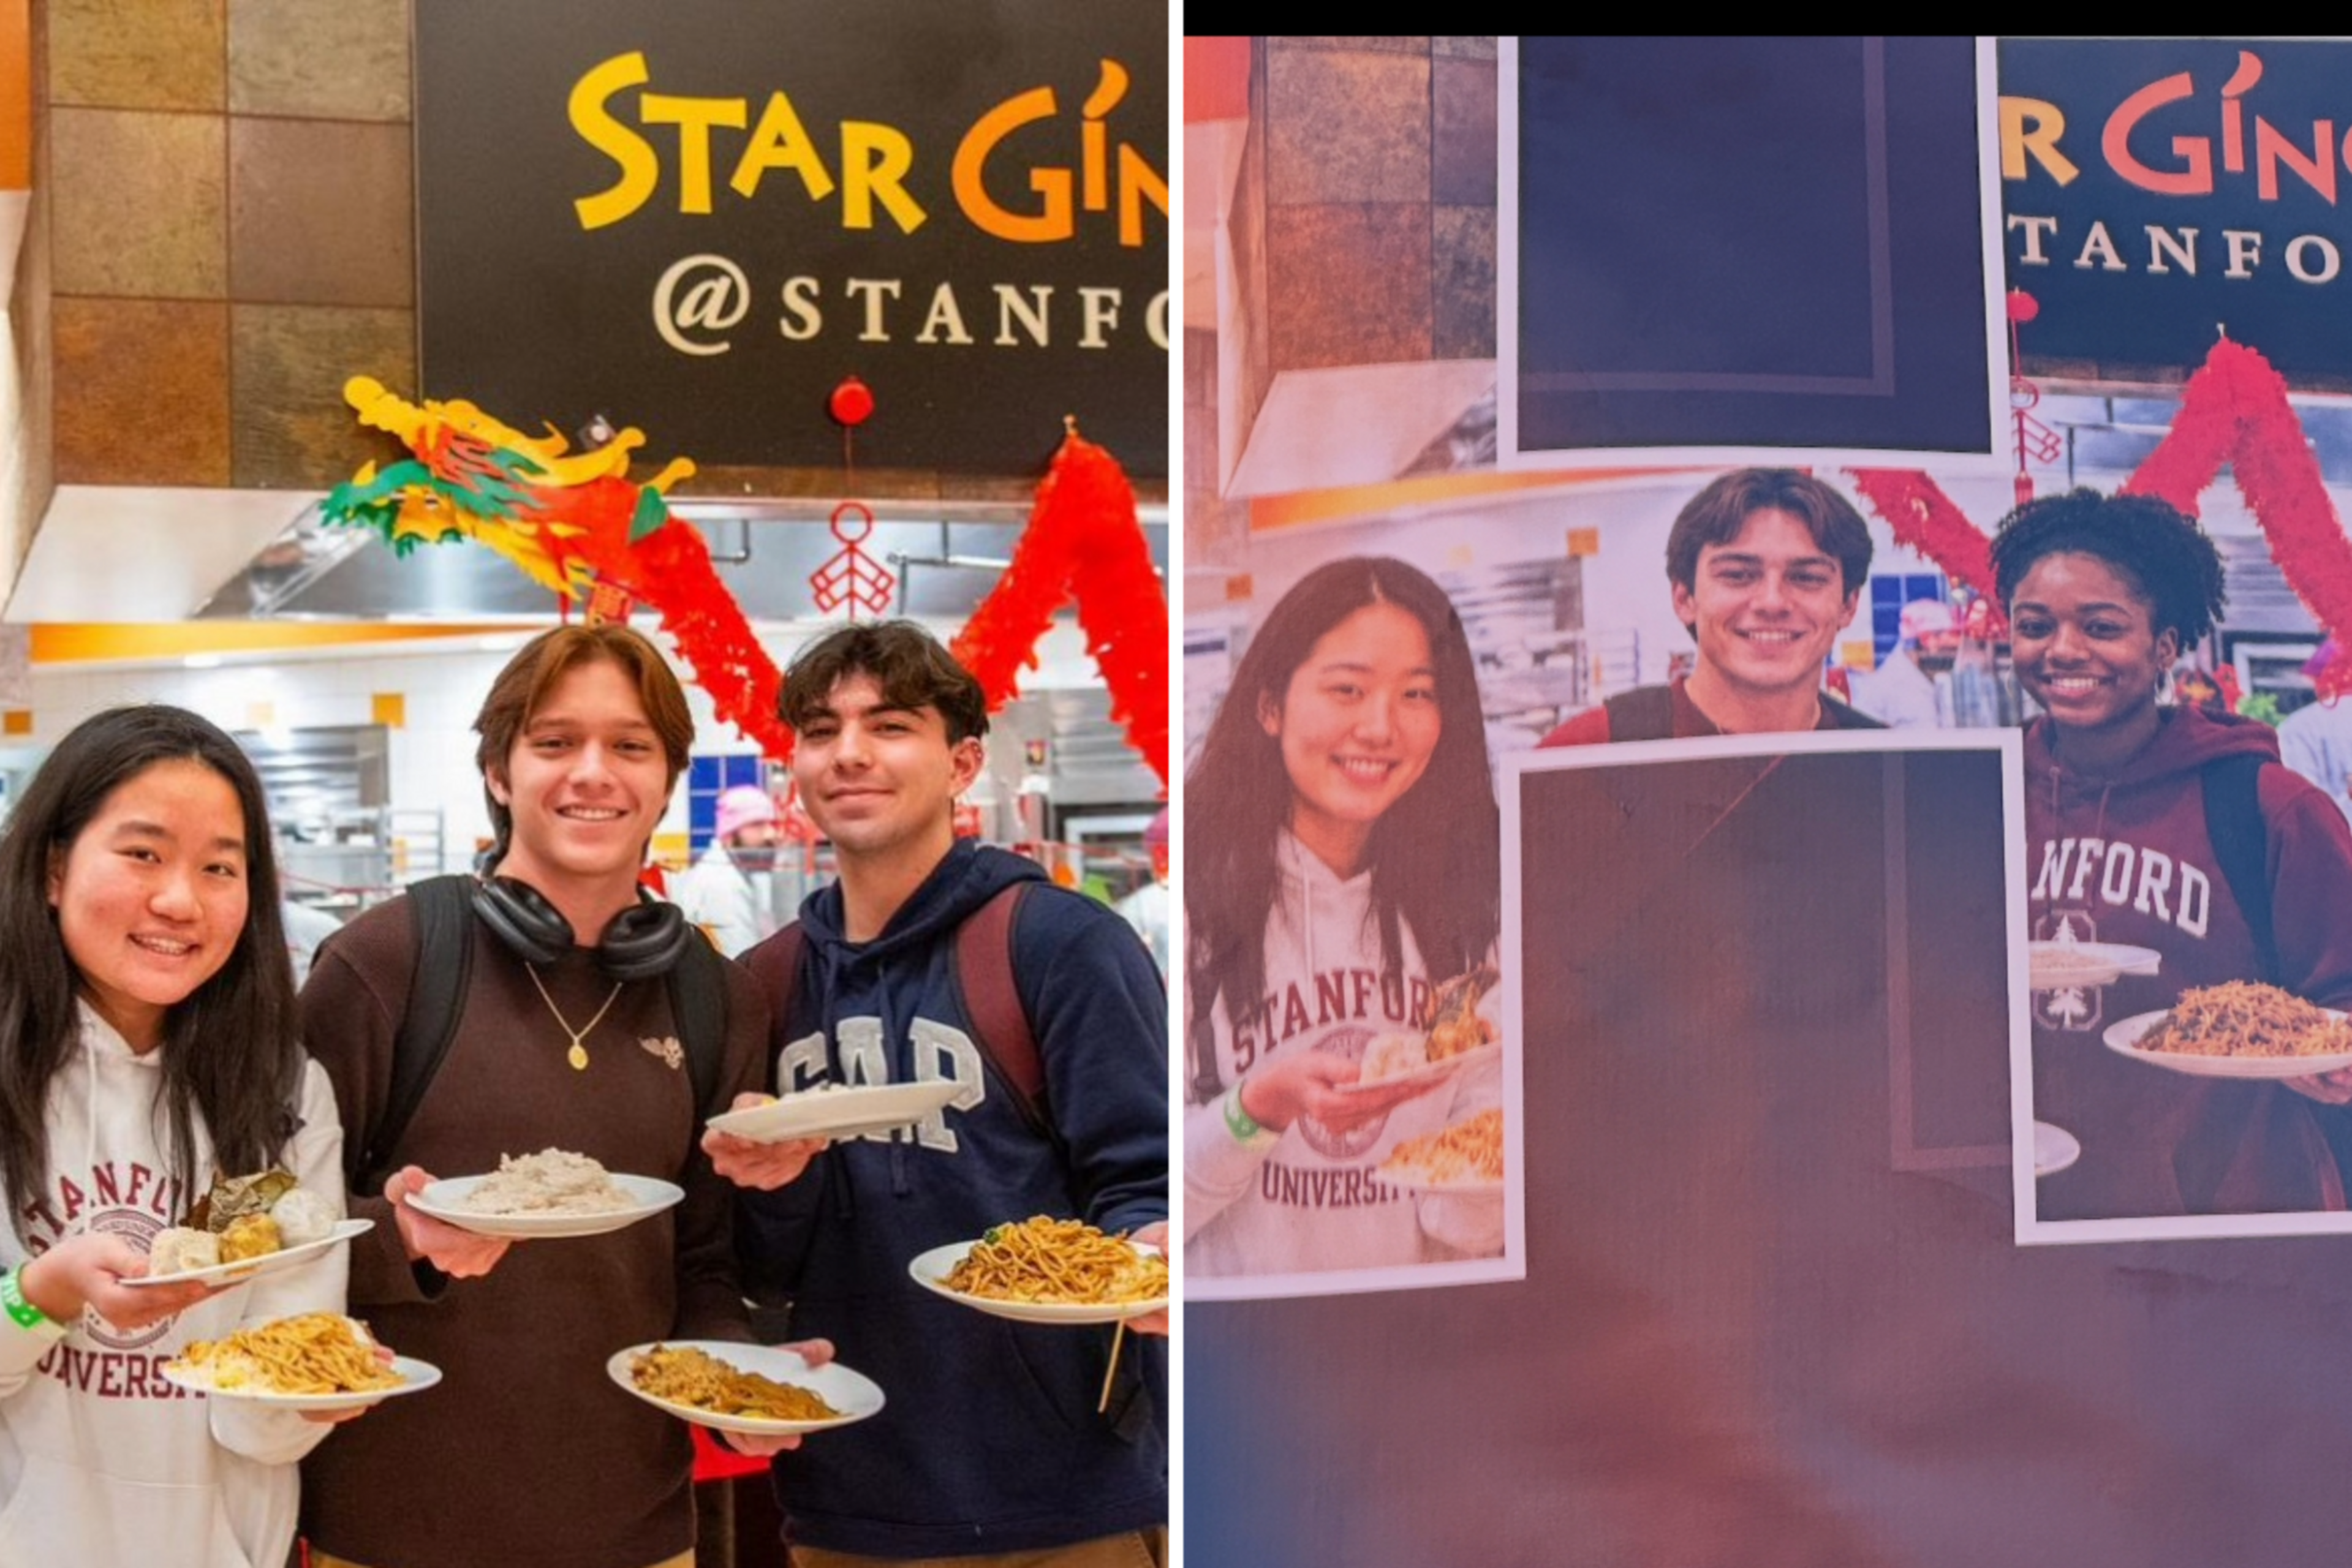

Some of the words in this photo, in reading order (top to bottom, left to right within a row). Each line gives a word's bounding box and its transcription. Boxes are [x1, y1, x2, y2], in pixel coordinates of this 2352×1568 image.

[567, 50, 928, 235] STAR
[2101, 50, 2352, 207] GIN
[2006, 213, 2342, 285] TANFO
